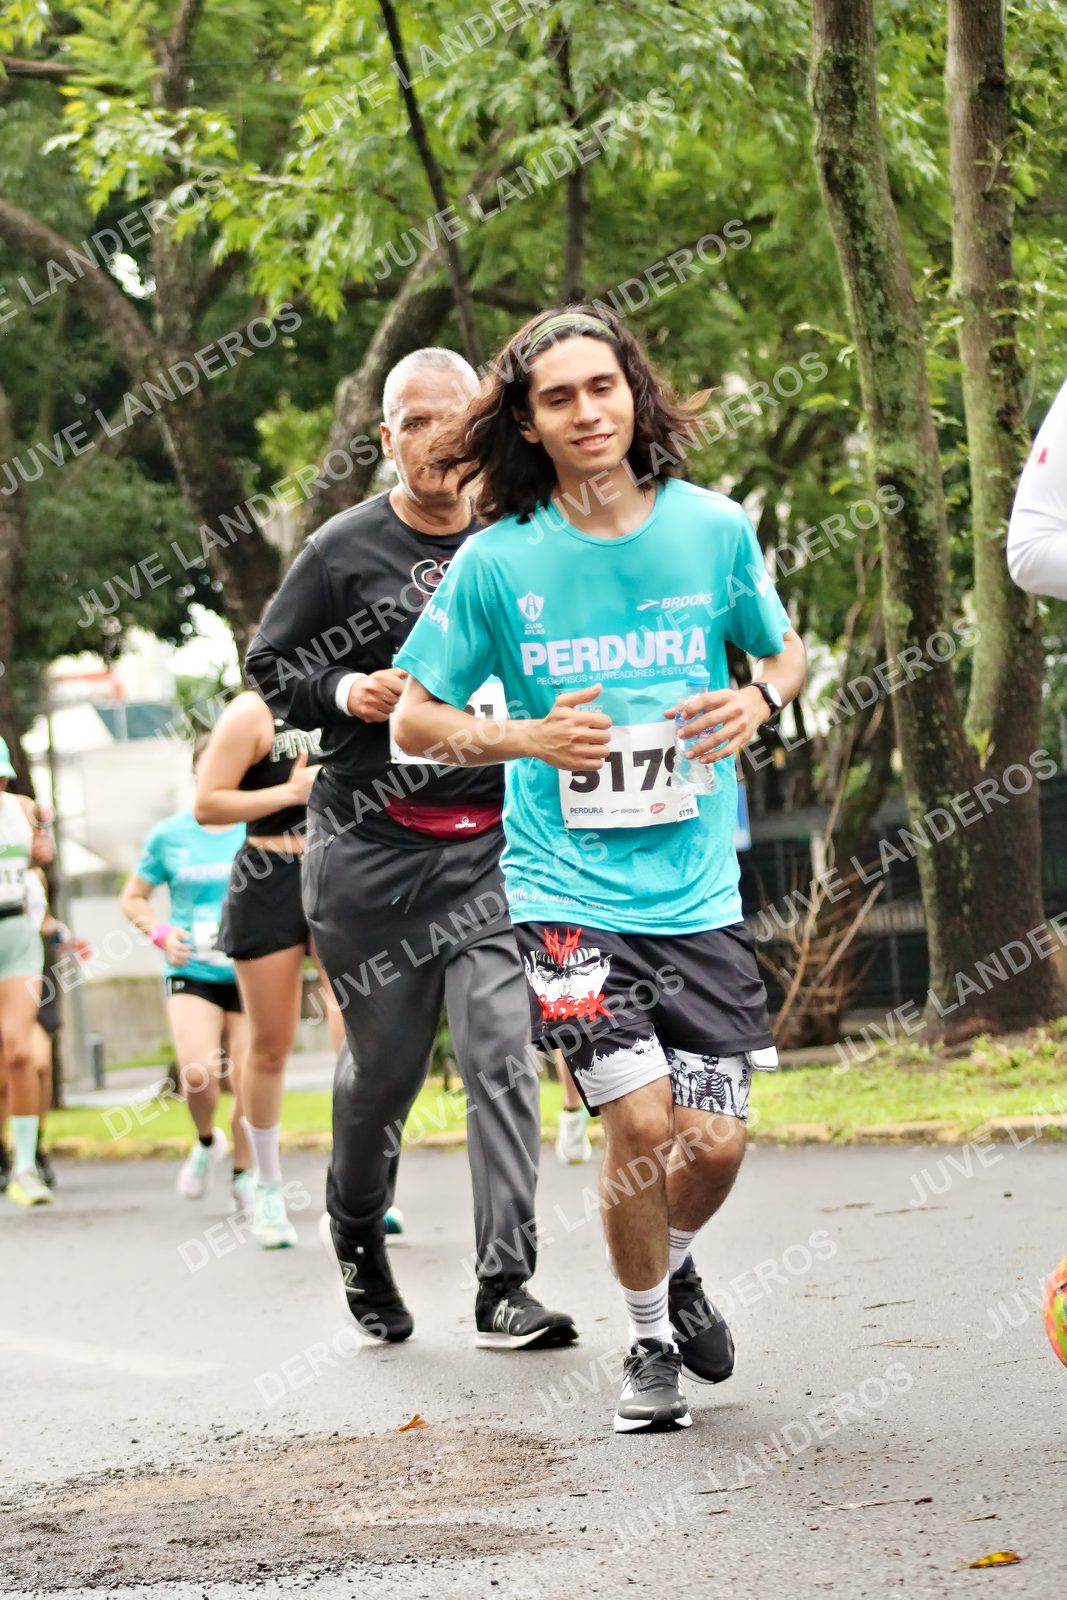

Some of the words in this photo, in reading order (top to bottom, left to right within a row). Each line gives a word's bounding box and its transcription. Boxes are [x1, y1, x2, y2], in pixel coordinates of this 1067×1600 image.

[661, 593, 713, 609] BROOKS
[520, 627, 706, 676] PERDURA
[537, 675, 588, 686] PEGPISOS
[679, 808, 694, 818] 5179
